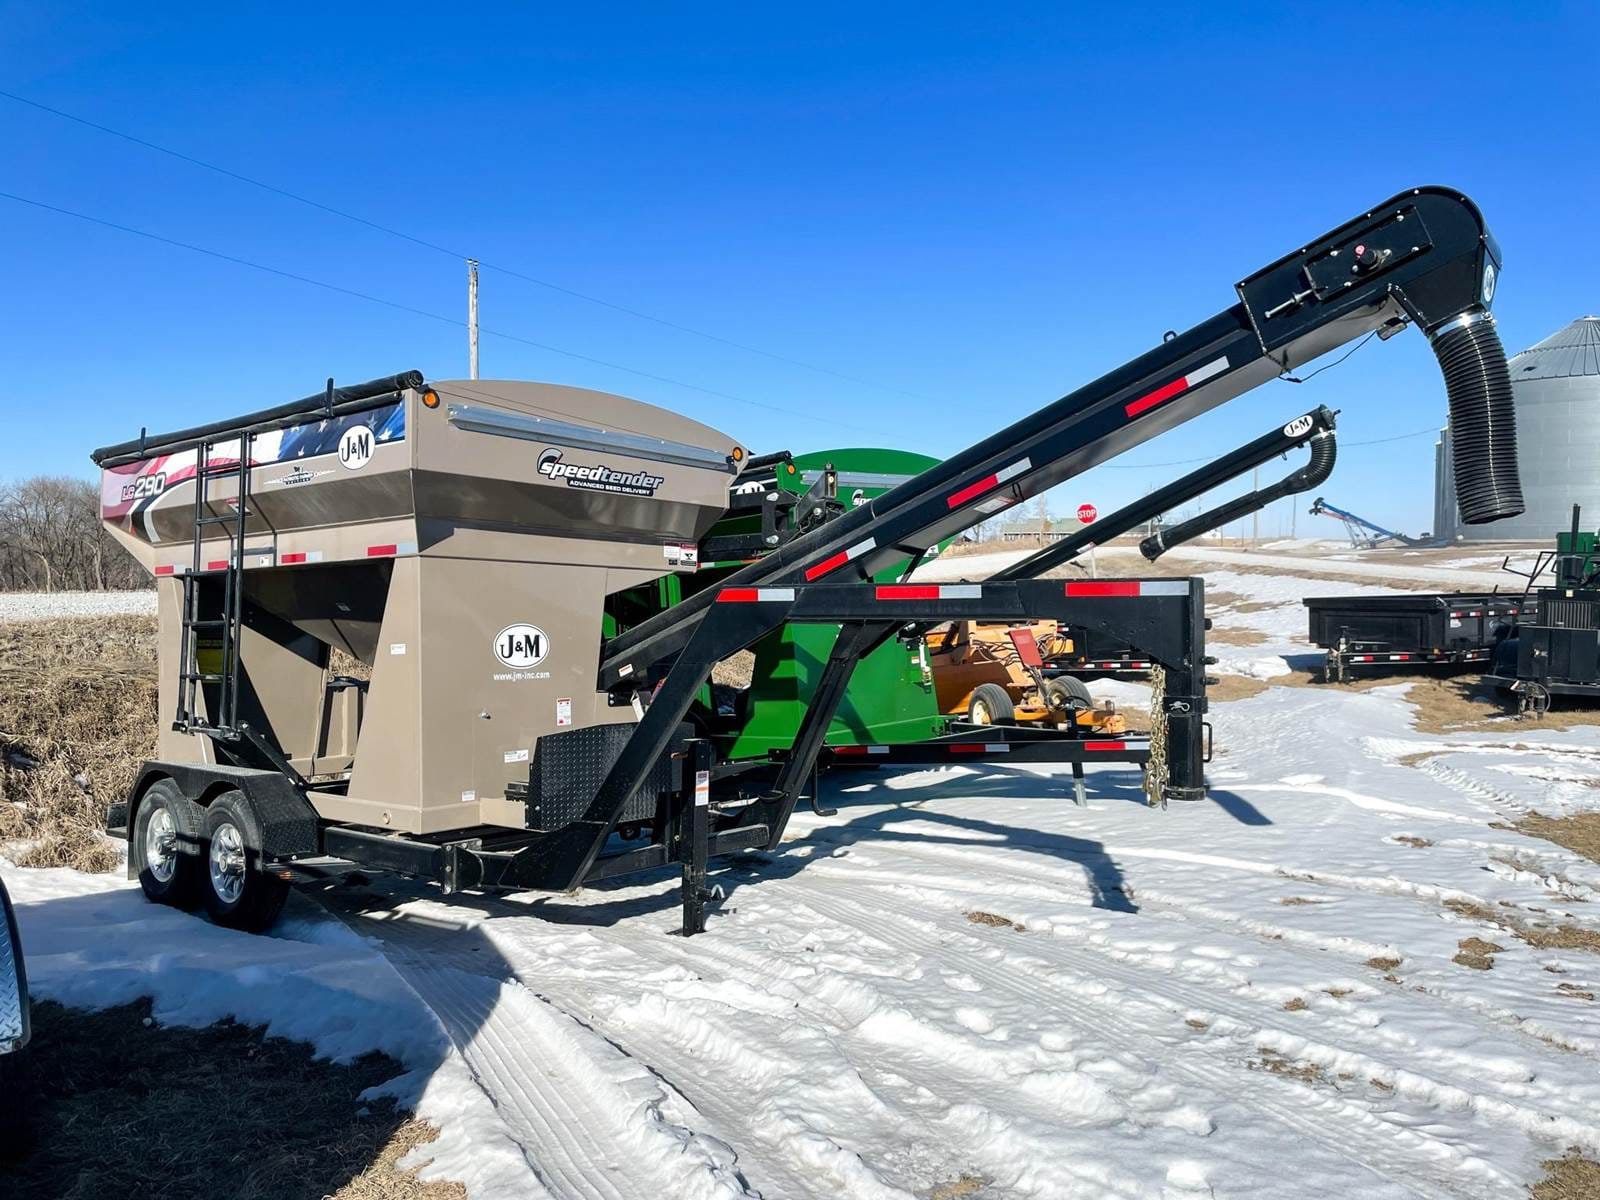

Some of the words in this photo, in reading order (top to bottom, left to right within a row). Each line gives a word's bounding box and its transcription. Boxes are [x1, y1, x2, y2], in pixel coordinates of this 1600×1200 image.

[1286, 417, 1310, 435] J&M
[341, 433, 370, 463] J&M
[569, 480, 605, 490] ADVANCED
[622, 487, 652, 496] DELIVERY
[1078, 509, 1096, 519] STOP
[500, 634, 541, 659] J&M
[493, 672, 550, 682] www.jm-inc.com
